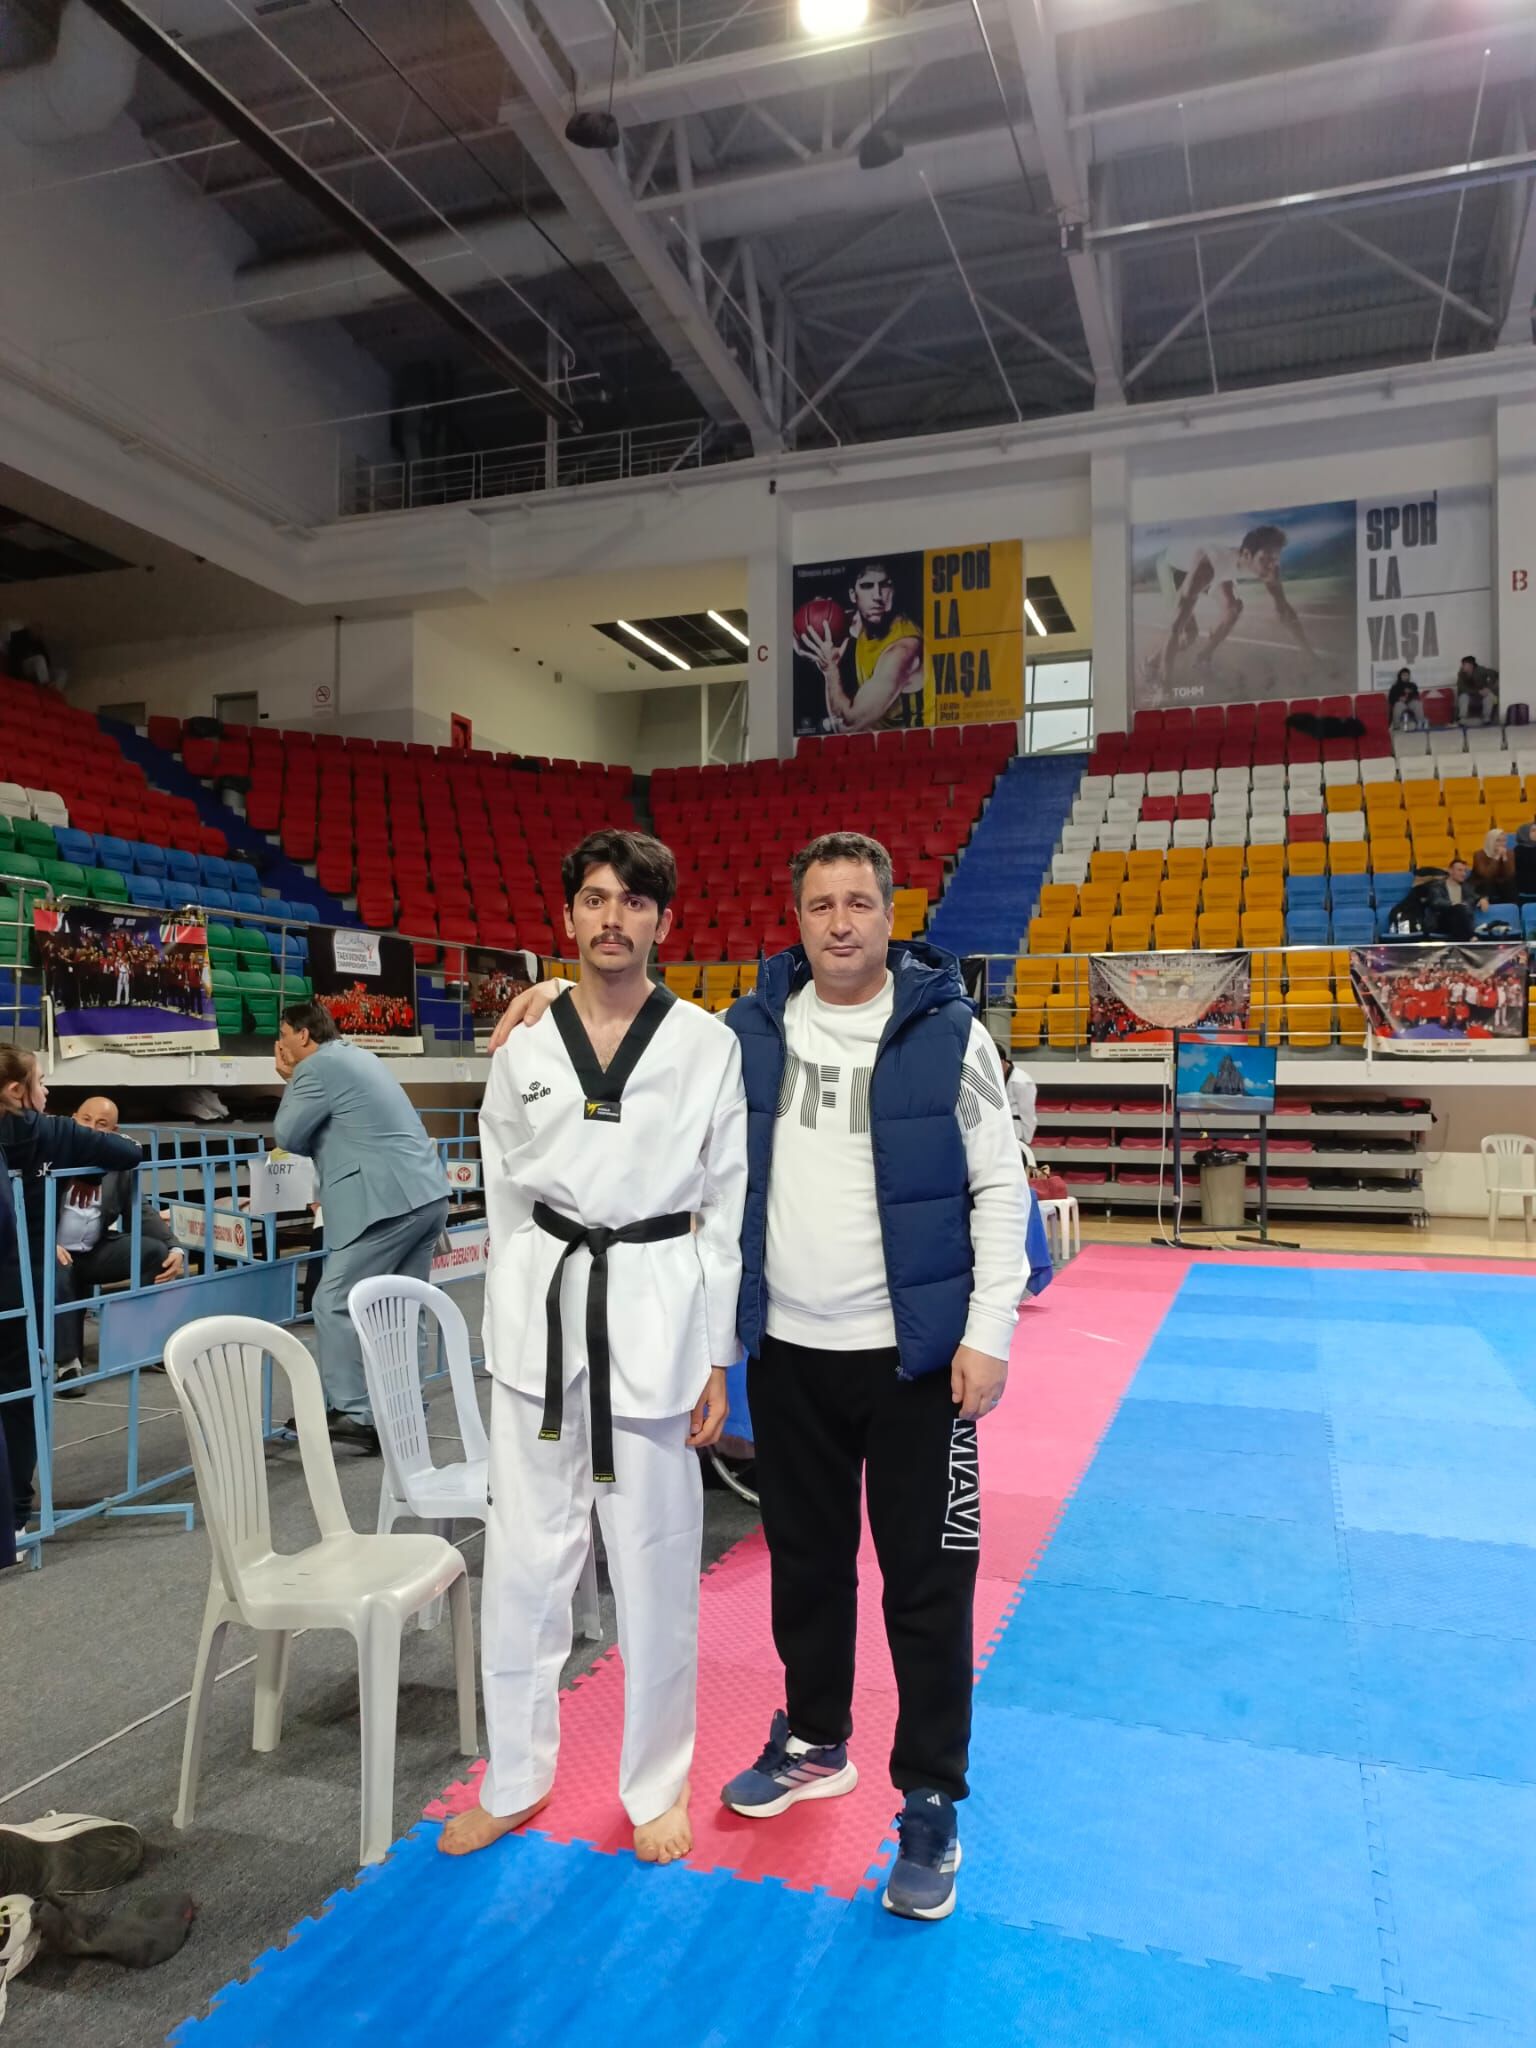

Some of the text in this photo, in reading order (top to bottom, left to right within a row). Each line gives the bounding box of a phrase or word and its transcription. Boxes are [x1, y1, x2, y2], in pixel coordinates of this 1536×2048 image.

[1369, 556, 1402, 601] LA
[1512, 569, 1528, 592] B
[934, 598, 960, 640] LA
[757, 644, 769, 662] C
[1366, 611, 1440, 665] YAŞA
[932, 649, 991, 698] YAŞA
[267, 1163, 295, 1175] KORT
[274, 1183, 280, 1194] 3
